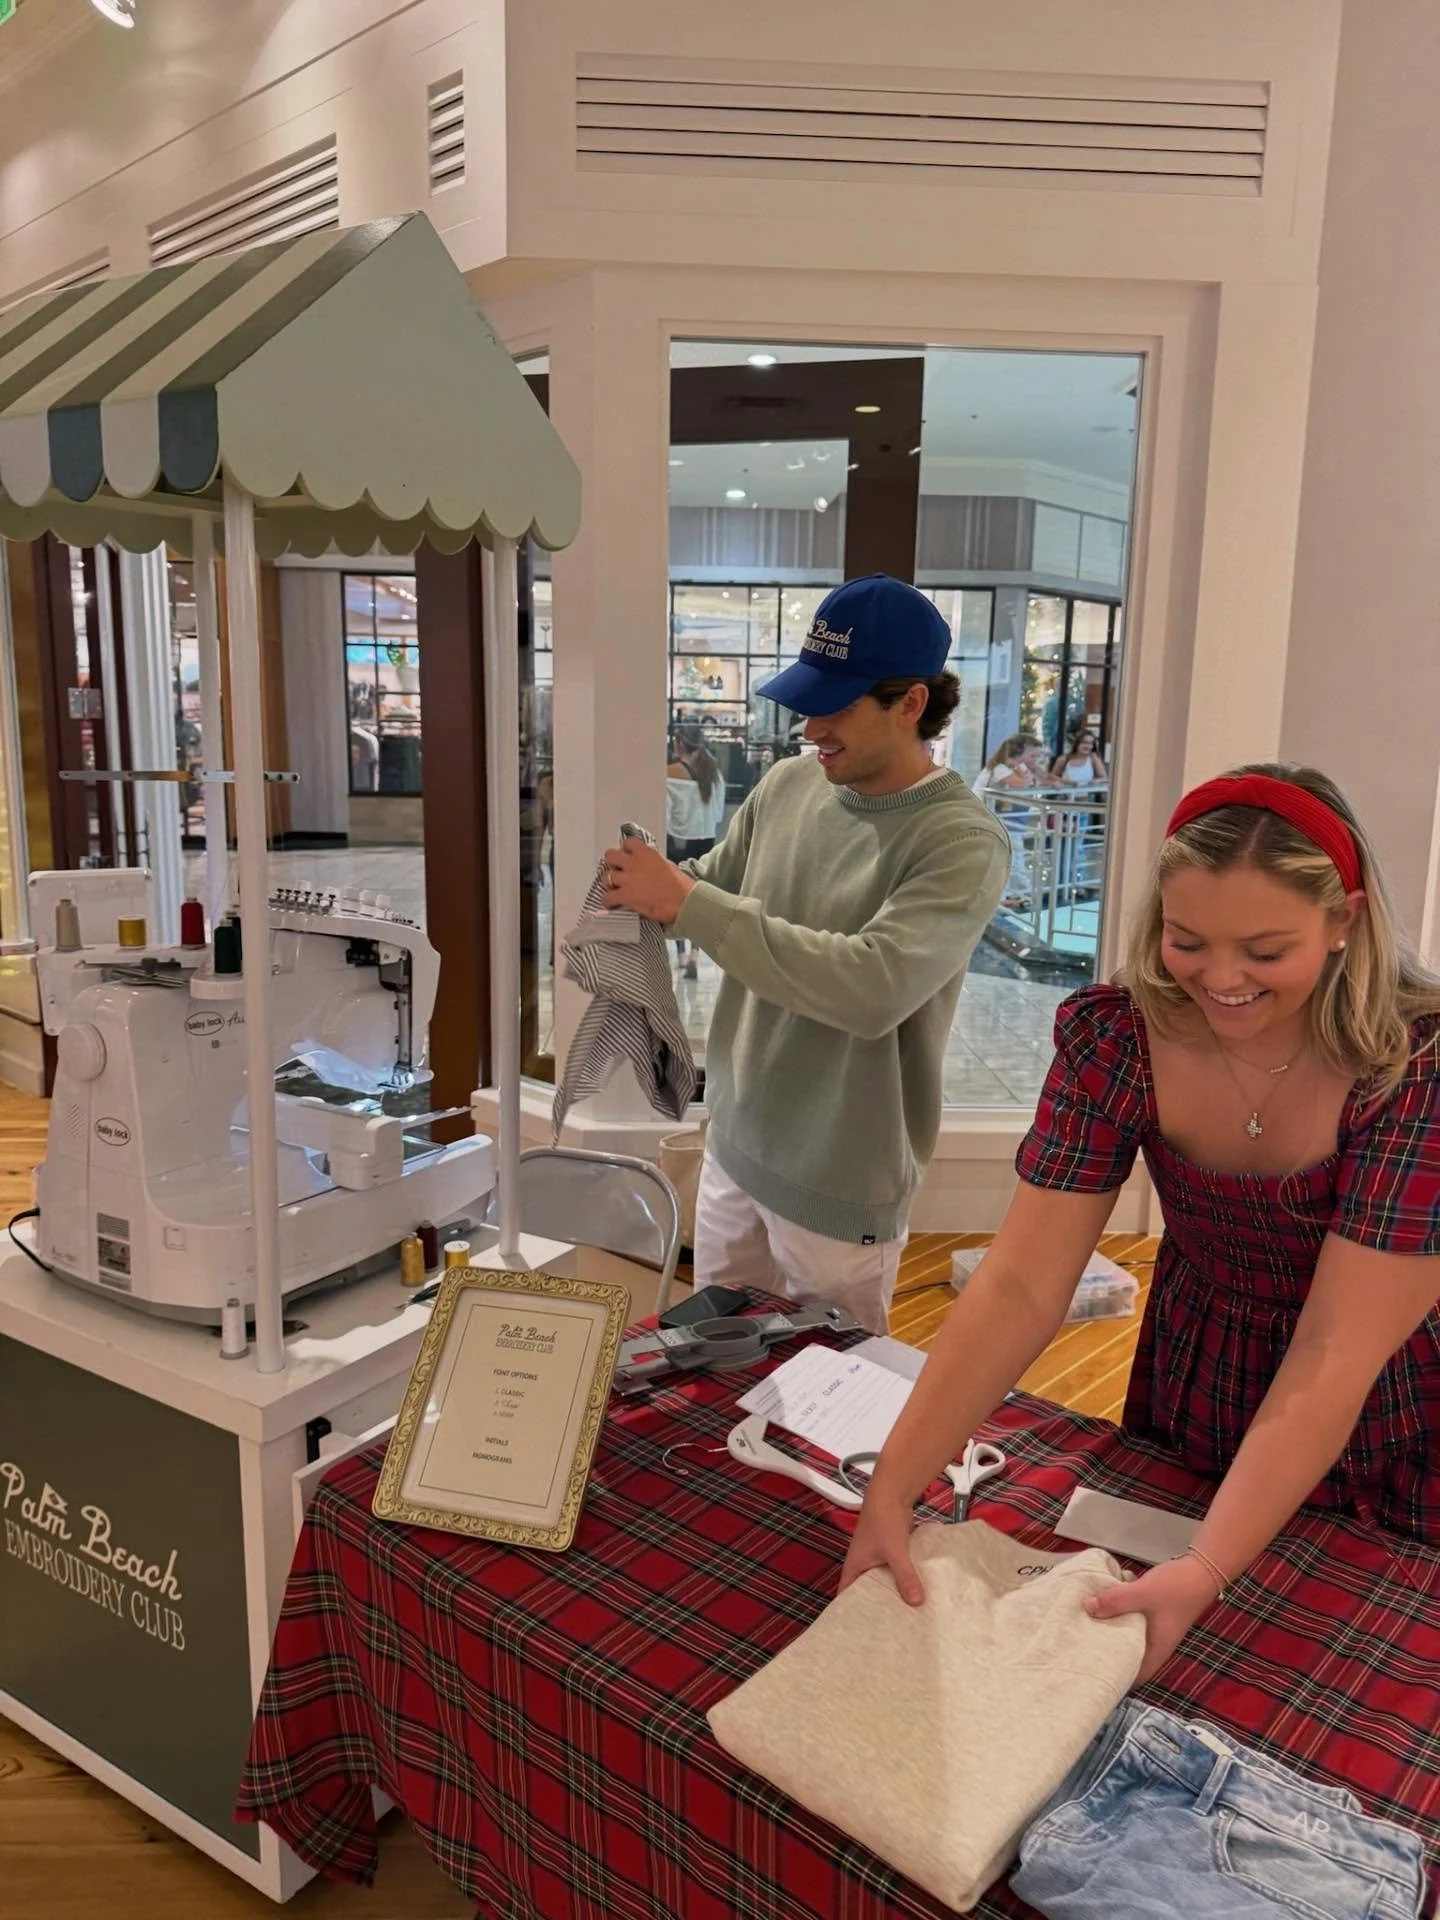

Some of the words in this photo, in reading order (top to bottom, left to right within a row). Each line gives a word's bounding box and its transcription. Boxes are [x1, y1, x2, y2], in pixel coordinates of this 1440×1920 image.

[812, 620, 853, 644] Beach
[826, 644, 848, 659] CLUB
[97, 1124, 113, 1137] baby
[114, 1129, 128, 1139] lock
[524, 1326, 558, 1343] Beach
[492, 1368, 510, 1377] FONT
[510, 1370, 538, 1381] OPTIONS
[0, 1462, 72, 1540] Palm
[79, 1504, 182, 1601] Beach
[4, 1518, 126, 1618] EMBROIDERY
[130, 1589, 186, 1651] CLUB
